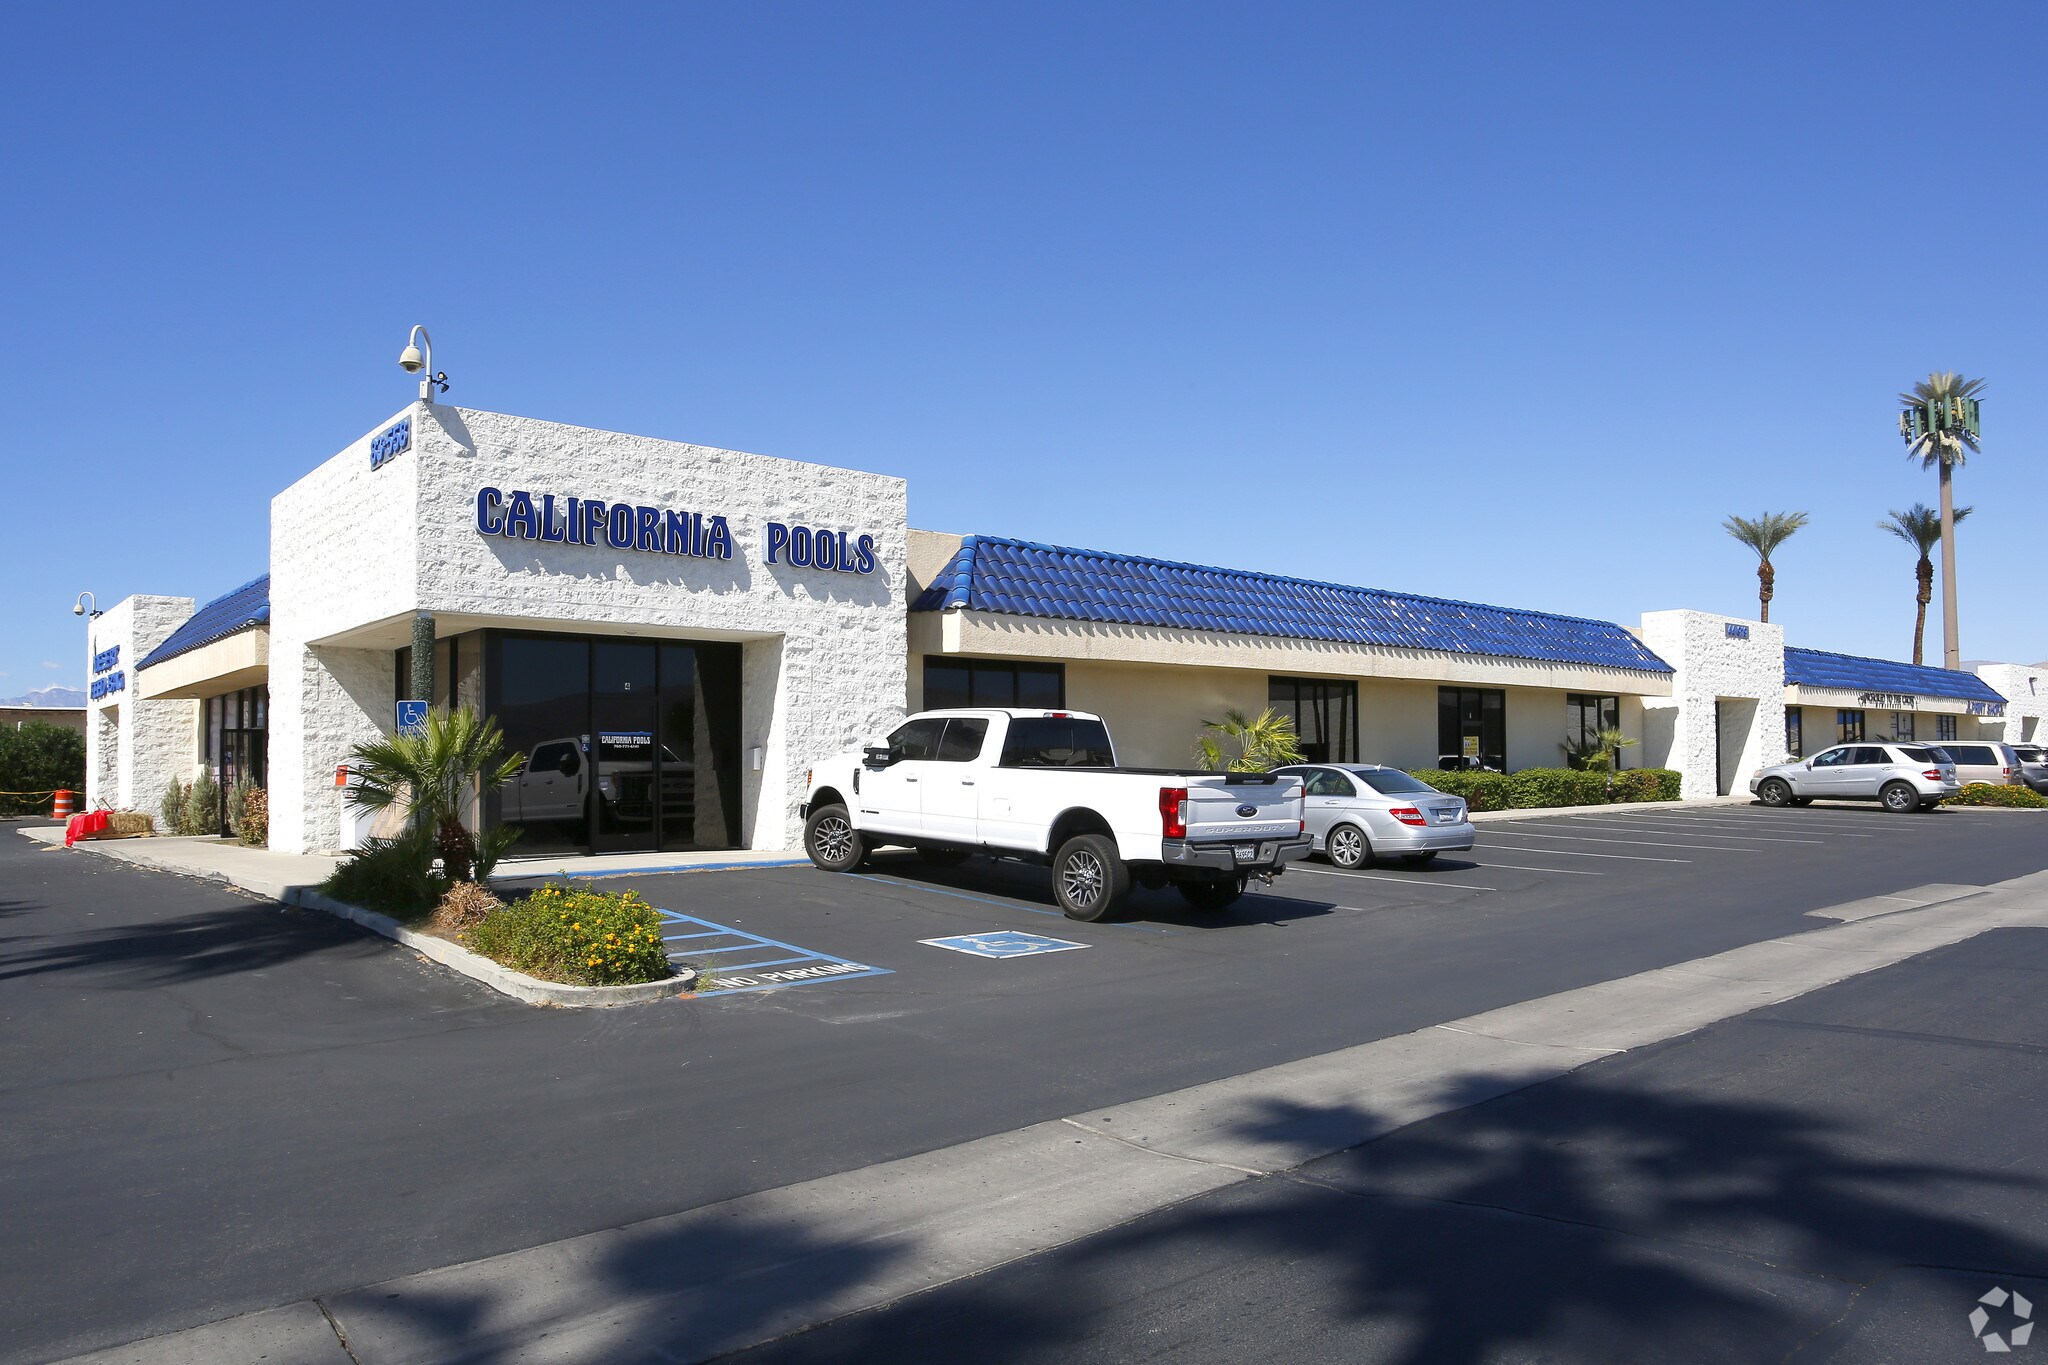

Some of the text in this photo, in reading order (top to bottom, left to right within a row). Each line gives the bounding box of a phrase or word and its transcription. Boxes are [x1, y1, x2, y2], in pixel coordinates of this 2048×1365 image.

[475, 486, 875, 575] CALIFORNIA POOLS
[601, 735, 651, 744] CALIFORNIA POOLS
[757, 963, 871, 983] PARKING
